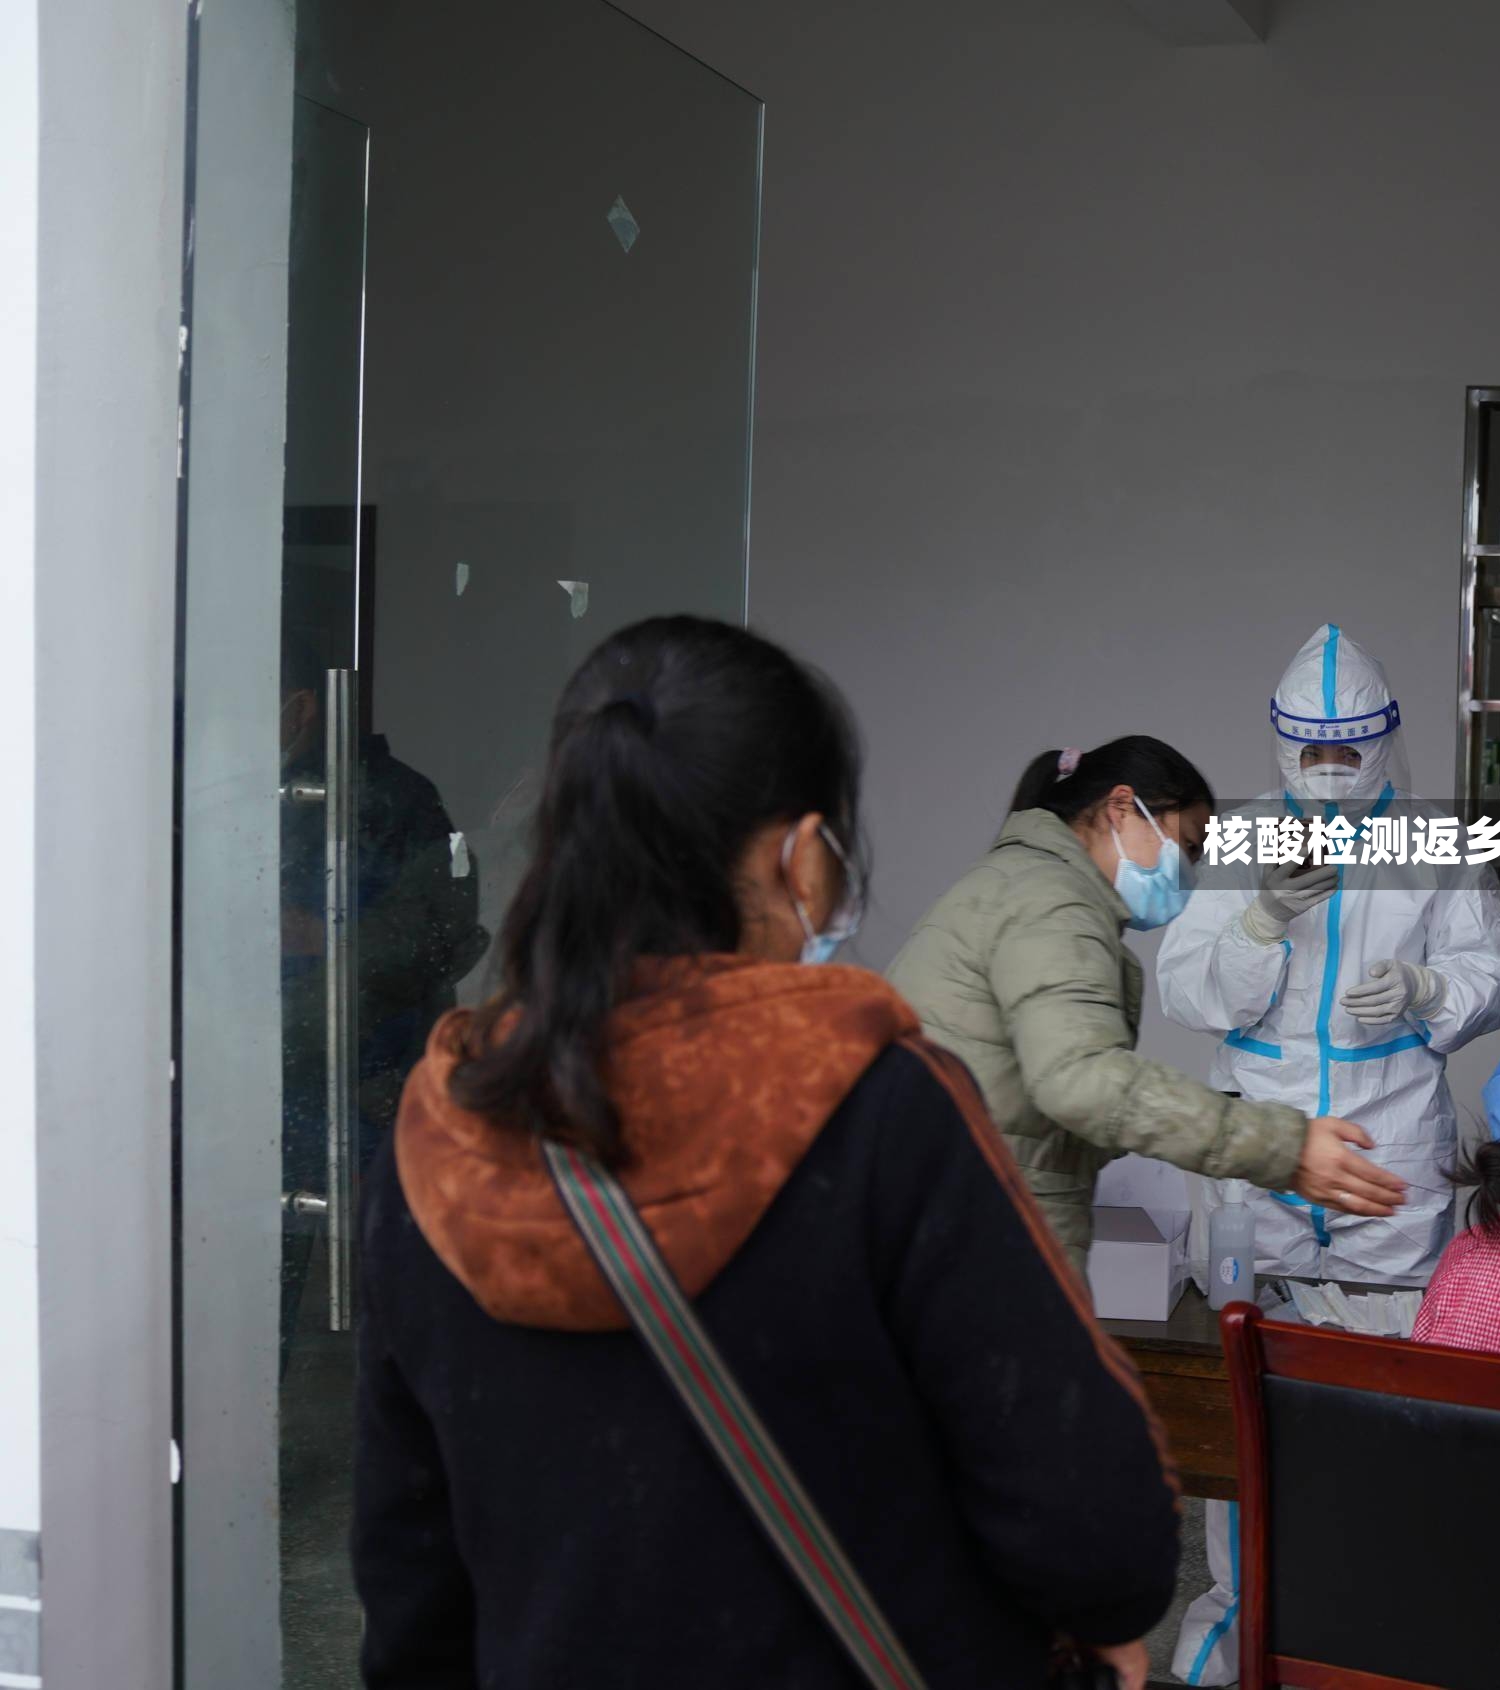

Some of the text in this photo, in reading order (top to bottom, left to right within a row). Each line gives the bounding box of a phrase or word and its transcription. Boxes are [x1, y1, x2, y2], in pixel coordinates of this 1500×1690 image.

[1291, 725, 1369, 738] 医用隔离面罩
